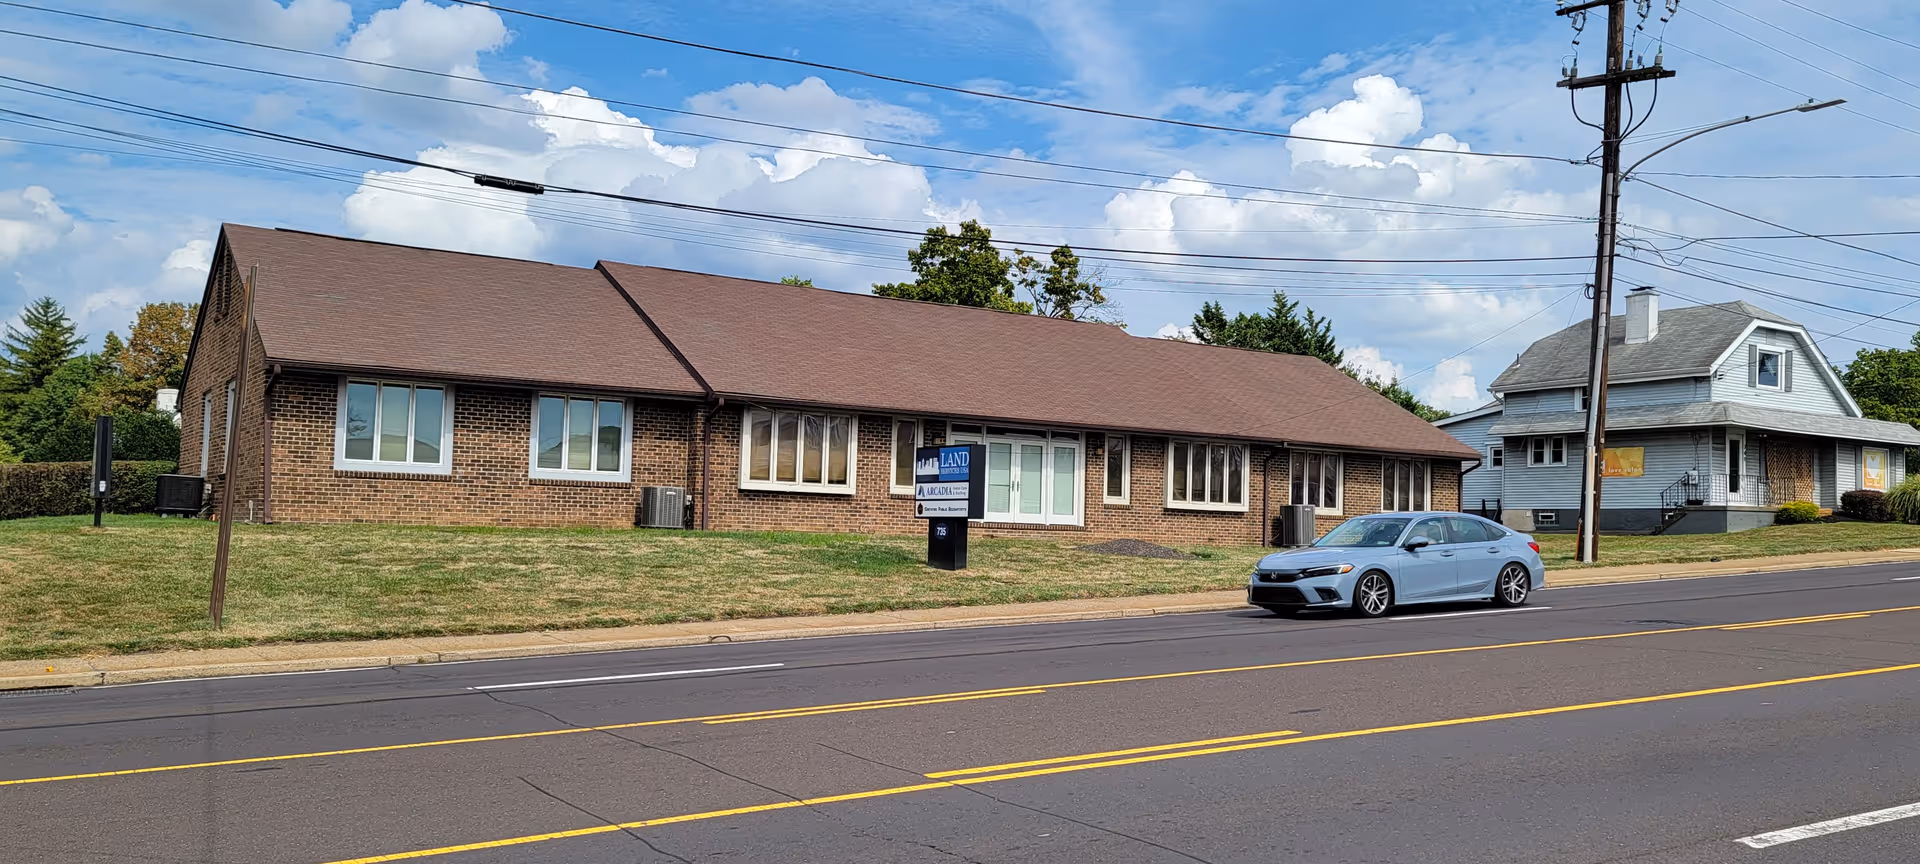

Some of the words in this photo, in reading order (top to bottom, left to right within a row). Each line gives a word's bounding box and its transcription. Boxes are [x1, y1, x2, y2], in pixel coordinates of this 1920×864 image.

[940, 451, 970, 467] LAND
[926, 486, 953, 496] ARCADIA
[936, 526, 947, 536] 735
